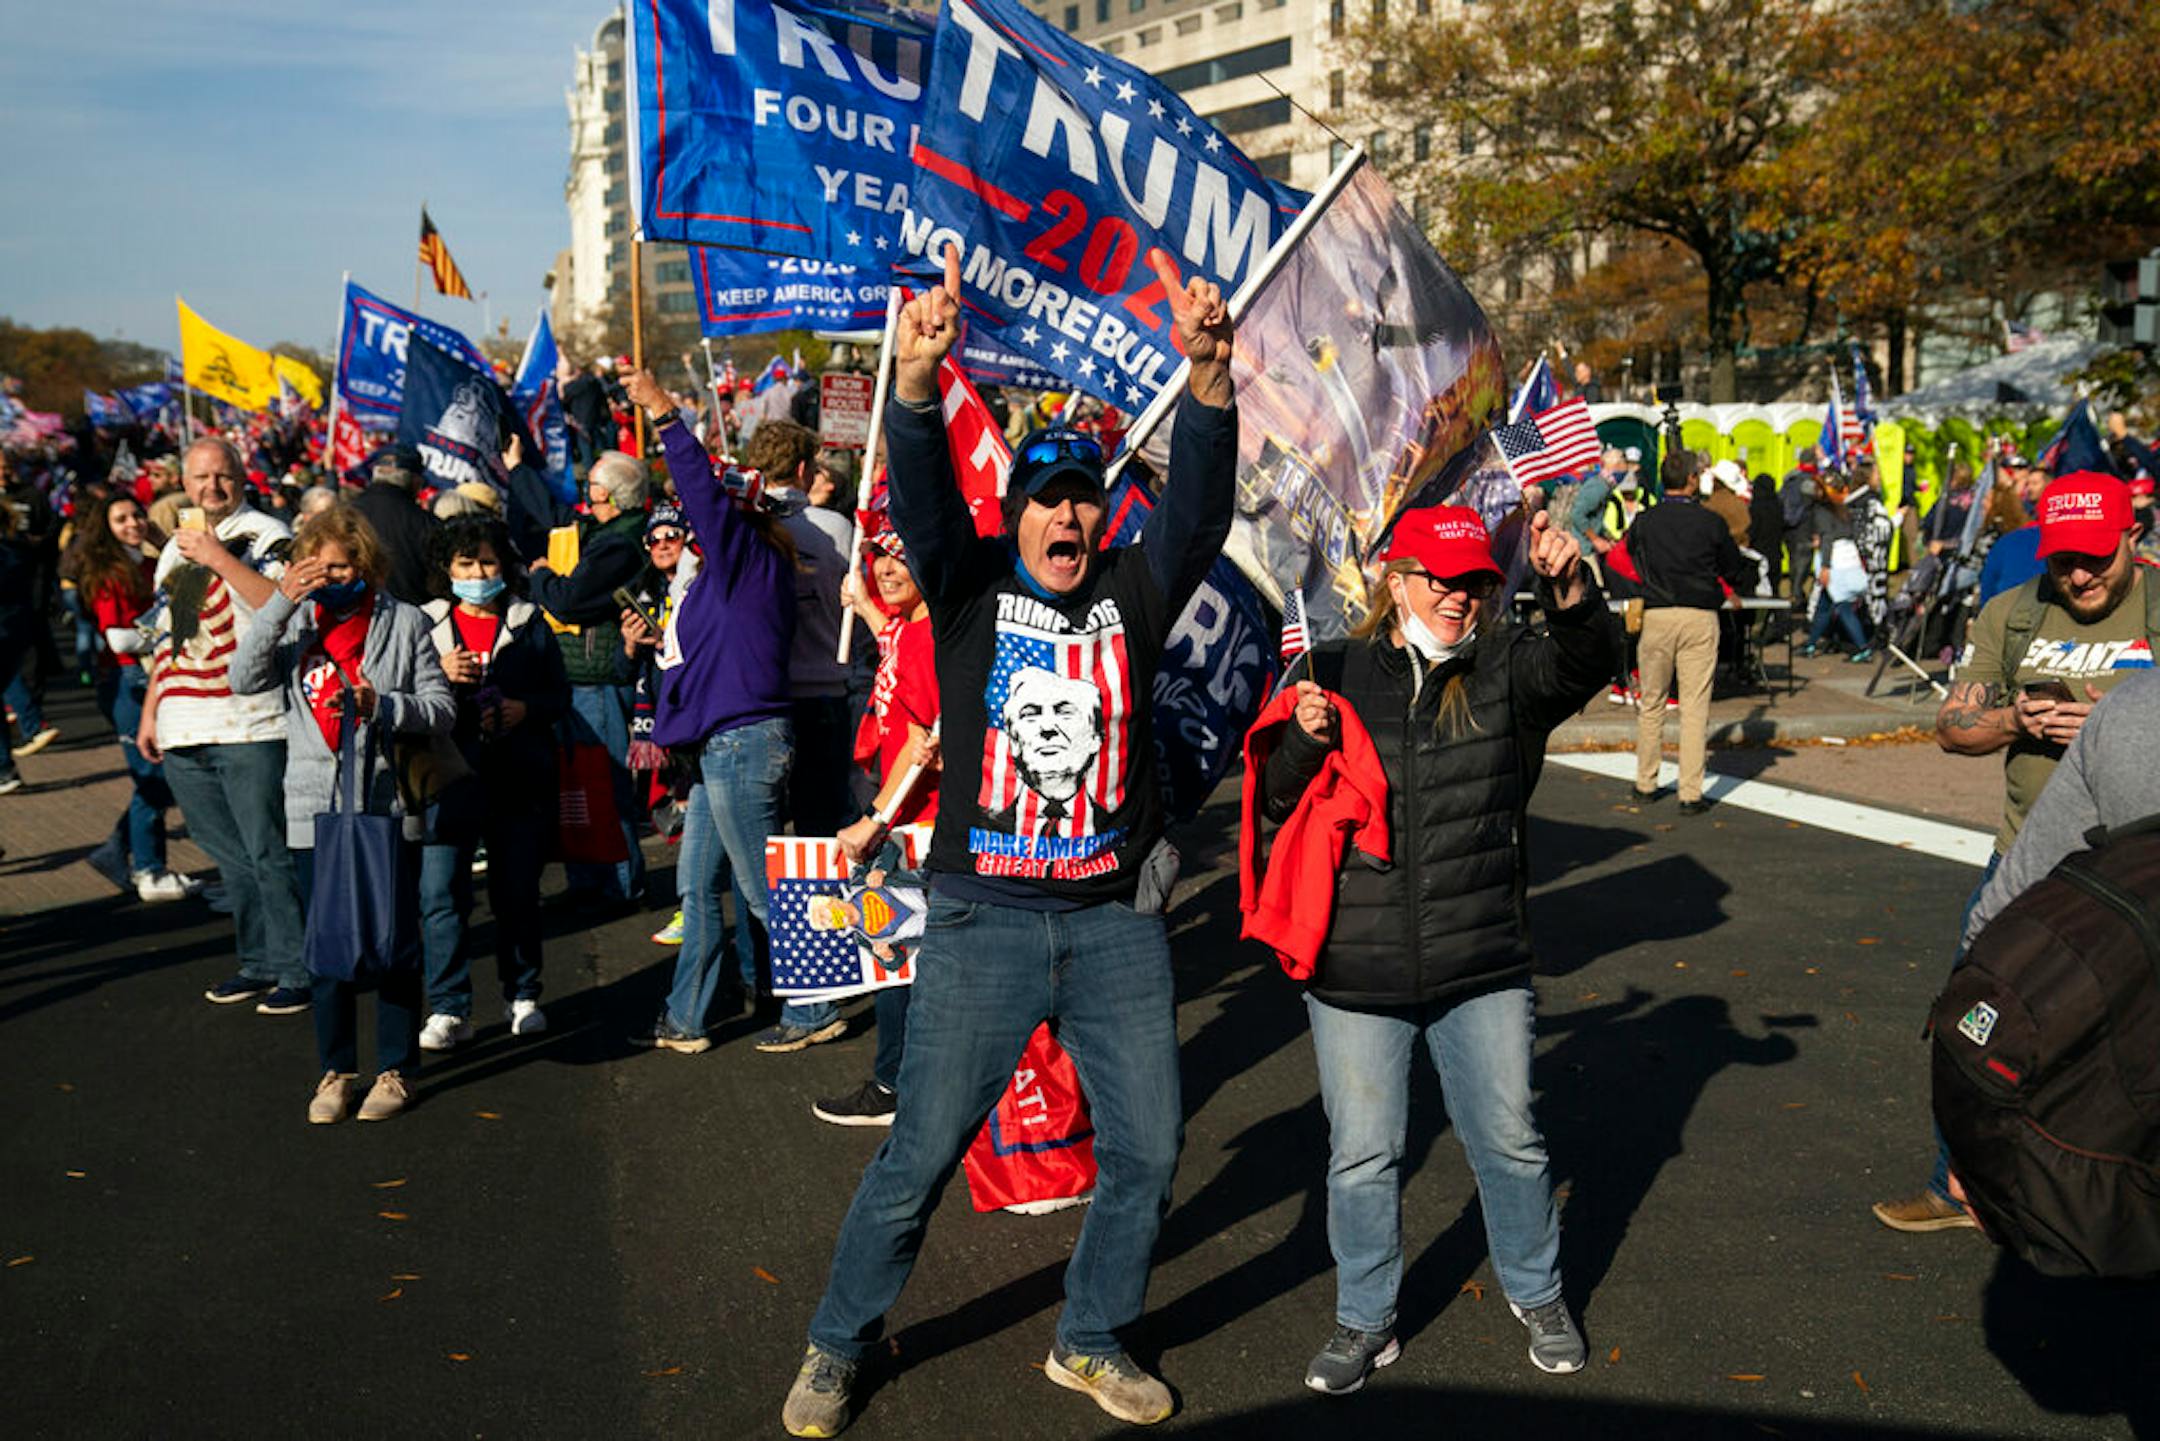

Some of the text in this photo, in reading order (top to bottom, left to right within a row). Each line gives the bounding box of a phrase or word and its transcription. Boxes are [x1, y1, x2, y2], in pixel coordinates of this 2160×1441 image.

[753, 87, 895, 153] FOUR
[949, 0, 1271, 282] TRUM
[898, 208, 965, 270] NO
[716, 288, 769, 307] KEEP
[773, 284, 856, 304] AMERICA
[1024, 188, 1187, 358] 202
[2047, 493, 2103, 512] TRUMP
[968, 826, 1032, 859] MAKE
[975, 850, 1120, 880] GREAT AGAIN
